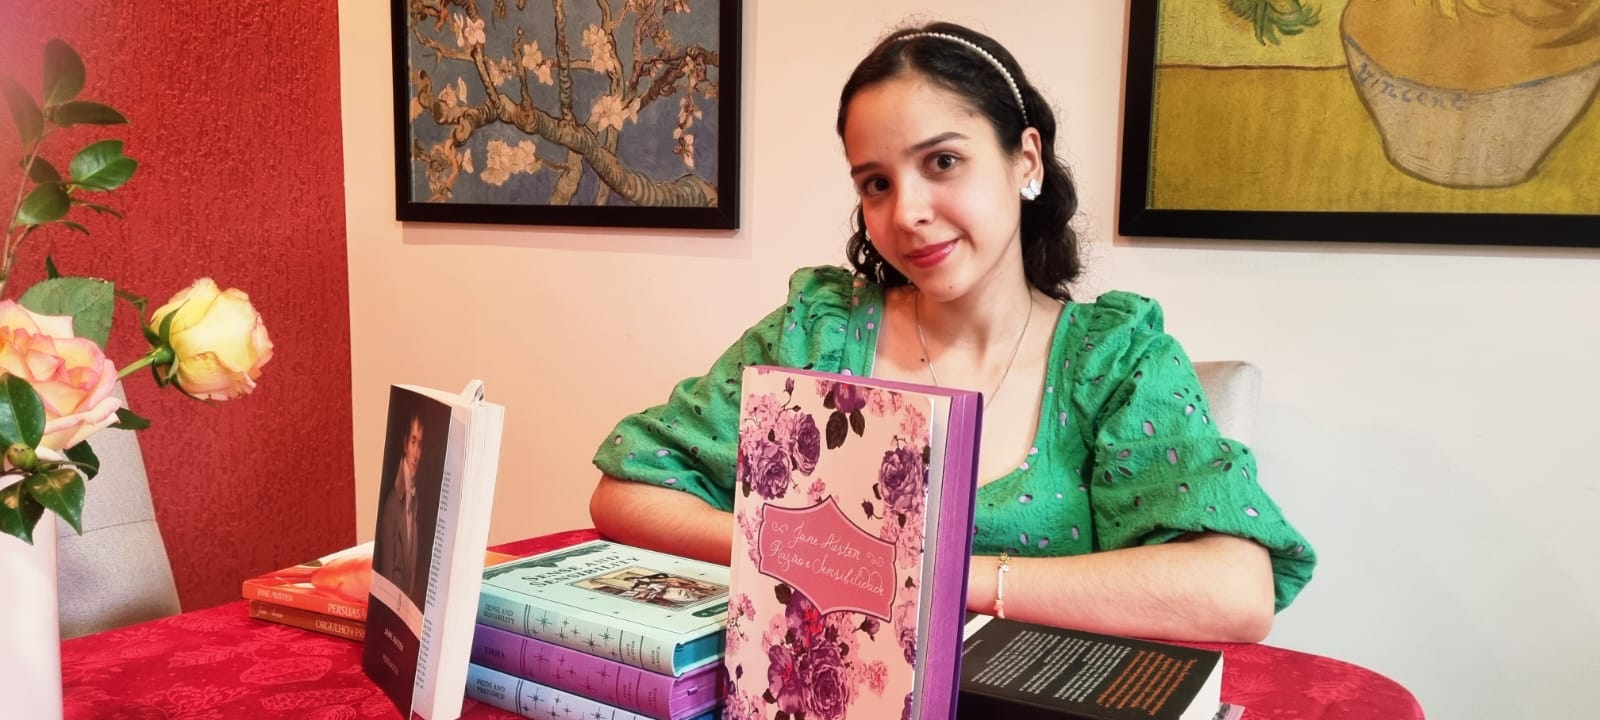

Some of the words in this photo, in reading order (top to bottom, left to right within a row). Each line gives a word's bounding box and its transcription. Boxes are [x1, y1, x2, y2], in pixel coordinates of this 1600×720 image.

[1356, 62, 1465, 111] Vincent
[787, 521, 818, 549] Jane
[820, 532, 861, 561] Austen
[521, 564, 580, 582] SENSE
[584, 554, 620, 568] AND
[529, 556, 641, 587] SENSIBILITY
[805, 560, 810, 568] e
[812, 553, 885, 596] Sensibilidade
[257, 587, 270, 598] JANE
[271, 591, 293, 602] AUSTEN
[485, 603, 500, 613] SENSE
[502, 607, 514, 617] AND
[315, 619, 350, 635] ORGULHO
[484, 646, 505, 658] EMMA
[476, 678, 492, 688] PRIDE
[493, 684, 506, 692] AND
[476, 686, 504, 700] PREJUDICE
